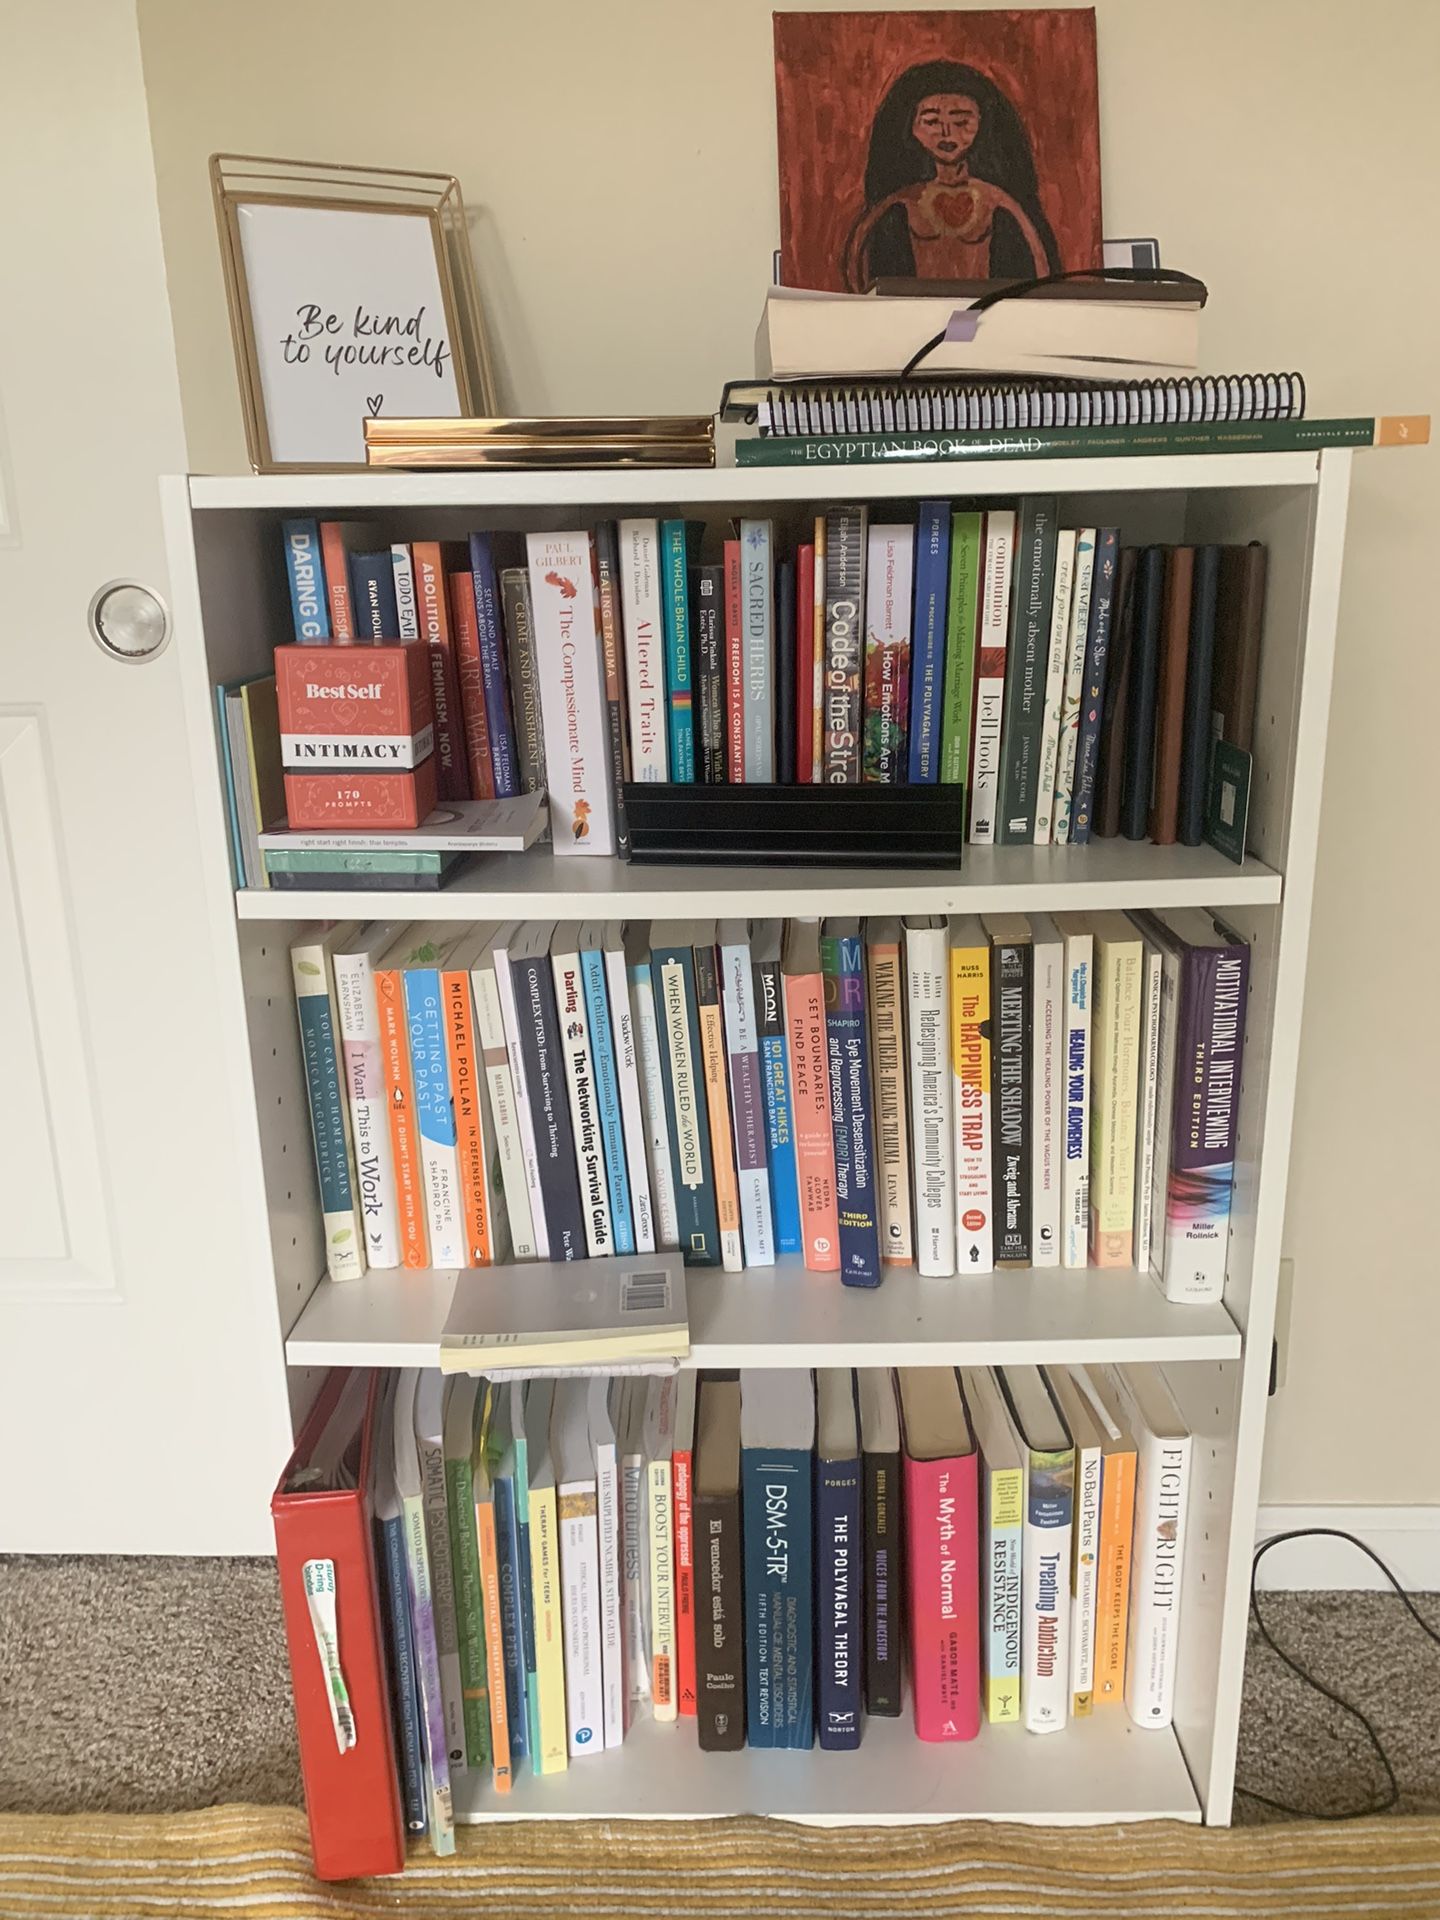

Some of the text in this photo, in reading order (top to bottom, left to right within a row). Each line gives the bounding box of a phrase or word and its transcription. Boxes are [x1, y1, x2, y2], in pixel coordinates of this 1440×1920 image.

[280, 335, 451, 377] to yourself
[297, 304, 425, 342] Be kind
[805, 440, 909, 459] EGYPTIAN
[913, 439, 967, 456] BOOK
[989, 437, 1042, 453] DEAD
[291, 535, 318, 616] DARING
[535, 556, 583, 566] GILBERT
[545, 544, 575, 554] PAUL
[672, 530, 682, 553] THE
[483, 588, 492, 617] SEVEN
[600, 560, 617, 678] HEALING TRAUMA
[749, 561, 764, 636] SACRED
[992, 537, 1006, 627] communion
[1023, 513, 1047, 714] the emotionally absent mother
[422, 563, 451, 769] ABOLITION. FEMINISM. NOW.
[473, 571, 491, 689] LESSONS ABOUT THE BRAIN
[487, 619, 496, 639] AND
[491, 650, 499, 670] HALF
[636, 618, 654, 689] Altered
[676, 646, 687, 682] CHILD
[732, 638, 740, 685] FREEDOM
[921, 519, 939, 778] PORGES THE POLYVAGAL THEORY
[515, 602, 539, 768] CRIME AND PUNISHMENT
[559, 605, 586, 793] The Compassionate Mind
[733, 690, 740, 698] IS
[750, 639, 765, 701] HERBS
[640, 698, 656, 754] Traits
[880, 651, 893, 769] How Emotions Are
[977, 695, 999, 789] bell hooks
[337, 790, 360, 799] 170
[764, 974, 777, 1022] MOON
[808, 998, 819, 1020] SET
[827, 1019, 860, 1027] SHAPIRO
[352, 1063, 366, 1101] Want
[411, 1011, 431, 1110] YOUR PAST
[424, 997, 447, 1125] GETTING PAST
[451, 983, 471, 1116] MICHAEL POLLAN
[527, 967, 558, 1158] COMPLEX PTSD: From Surviving to Thriving
[668, 974, 696, 1175] WHEN WOMEN RULED the WORLD
[794, 1019, 808, 1095] FIND PEACE
[960, 995, 983, 1151] The HAPPINESS TRAP
[1001, 987, 1022, 1147] MEETING THE SHADOW
[1204, 959, 1242, 1149] MOTIVATIONAL INTERVIEWING
[358, 1106, 371, 1138] This
[564, 971, 608, 1245] Darling The Networking Survival Guide
[772, 1040, 789, 1144] 101 GREAT HIKES
[829, 1037, 849, 1199] and Reprocessing Therapy
[845, 1038, 869, 1189] Eye Movement Desensitization
[1190, 1042, 1205, 1148] THIRD EDITION
[361, 1142, 370, 1155] to
[361, 1156, 383, 1216] Work
[839, 1219, 873, 1228] EDITION
[842, 1211, 868, 1220] THIRD
[1186, 1231, 1219, 1239] Rollnick
[824, 1478, 857, 1487] PORGES
[1082, 1460, 1097, 1547] No Bad Parts
[654, 1494, 669, 1582] BOOST YOUR
[937, 1472, 958, 1620] The Myth of Normal
[1116, 1544, 1125, 1561] THE
[710, 1519, 726, 1648] El vencedor está solo
[834, 1515, 848, 1687] THE POLYVAGAL THEORY
[993, 1540, 1007, 1633] RESISTANCE
[1036, 1552, 1061, 1677] Treating Addiction
[1112, 1592, 1122, 1620] KEEPS
[1113, 1564, 1124, 1590] BODY
[1006, 1570, 1020, 1669] INDIGENOUS
[1110, 1644, 1119, 1670] SCORE
[1112, 1622, 1120, 1641] THE
[707, 1673, 734, 1682] Paulo
